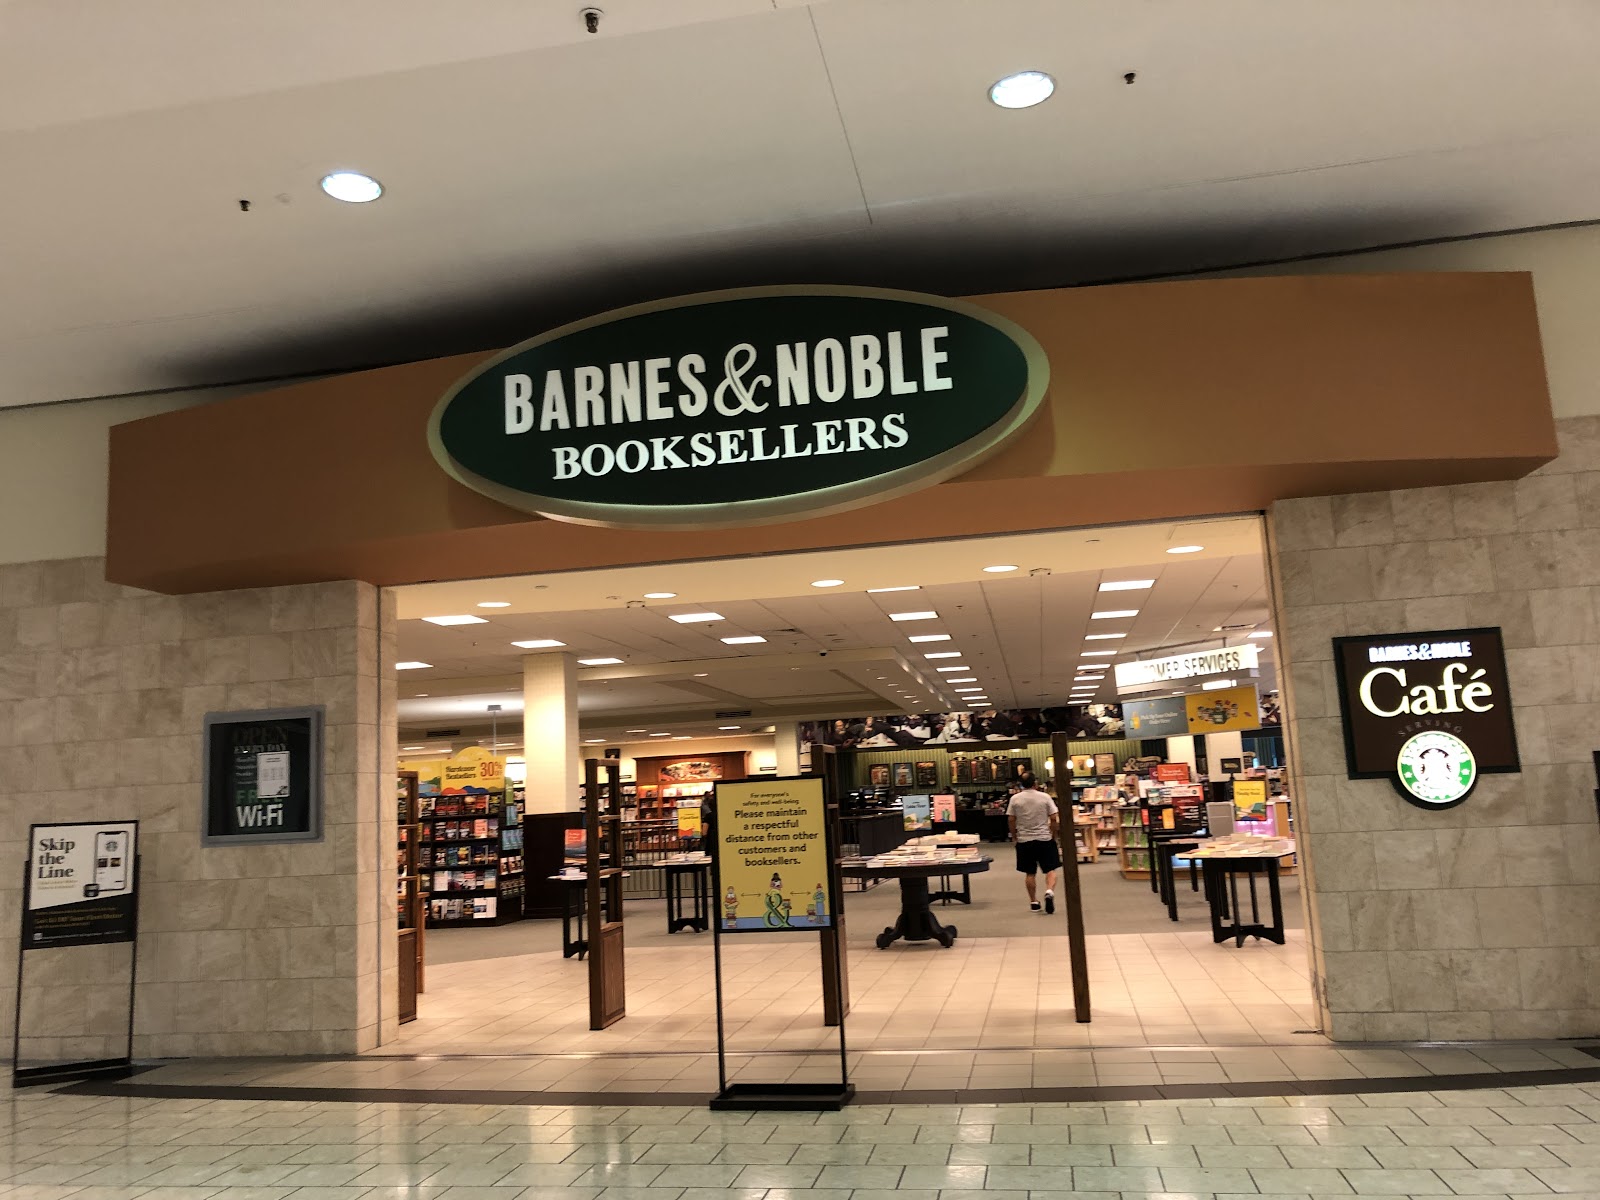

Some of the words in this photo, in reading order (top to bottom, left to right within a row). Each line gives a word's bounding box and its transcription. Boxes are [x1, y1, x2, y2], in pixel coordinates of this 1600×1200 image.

[504, 352, 707, 435] BARNES
[776, 326, 954, 406] NOBLE
[551, 413, 910, 480] BOOKSELLERS
[1184, 651, 1241, 676] SERVICES
[1359, 662, 1495, 718] Café
[1397, 719, 1463, 736] SERVING
[235, 803, 284, 828] Wi-Fi
[734, 809, 763, 818] Please
[766, 807, 807, 817] maintain
[751, 819, 799, 832] respectful
[725, 834, 764, 843] distance
[766, 832, 790, 841] from
[792, 831, 819, 840] other
[38, 838, 75, 854] Skip
[738, 845, 787, 855] customers
[789, 843, 807, 852] and
[38, 852, 66, 865] the
[745, 856, 801, 867] booksellers.
[37, 866, 74, 879] Line
